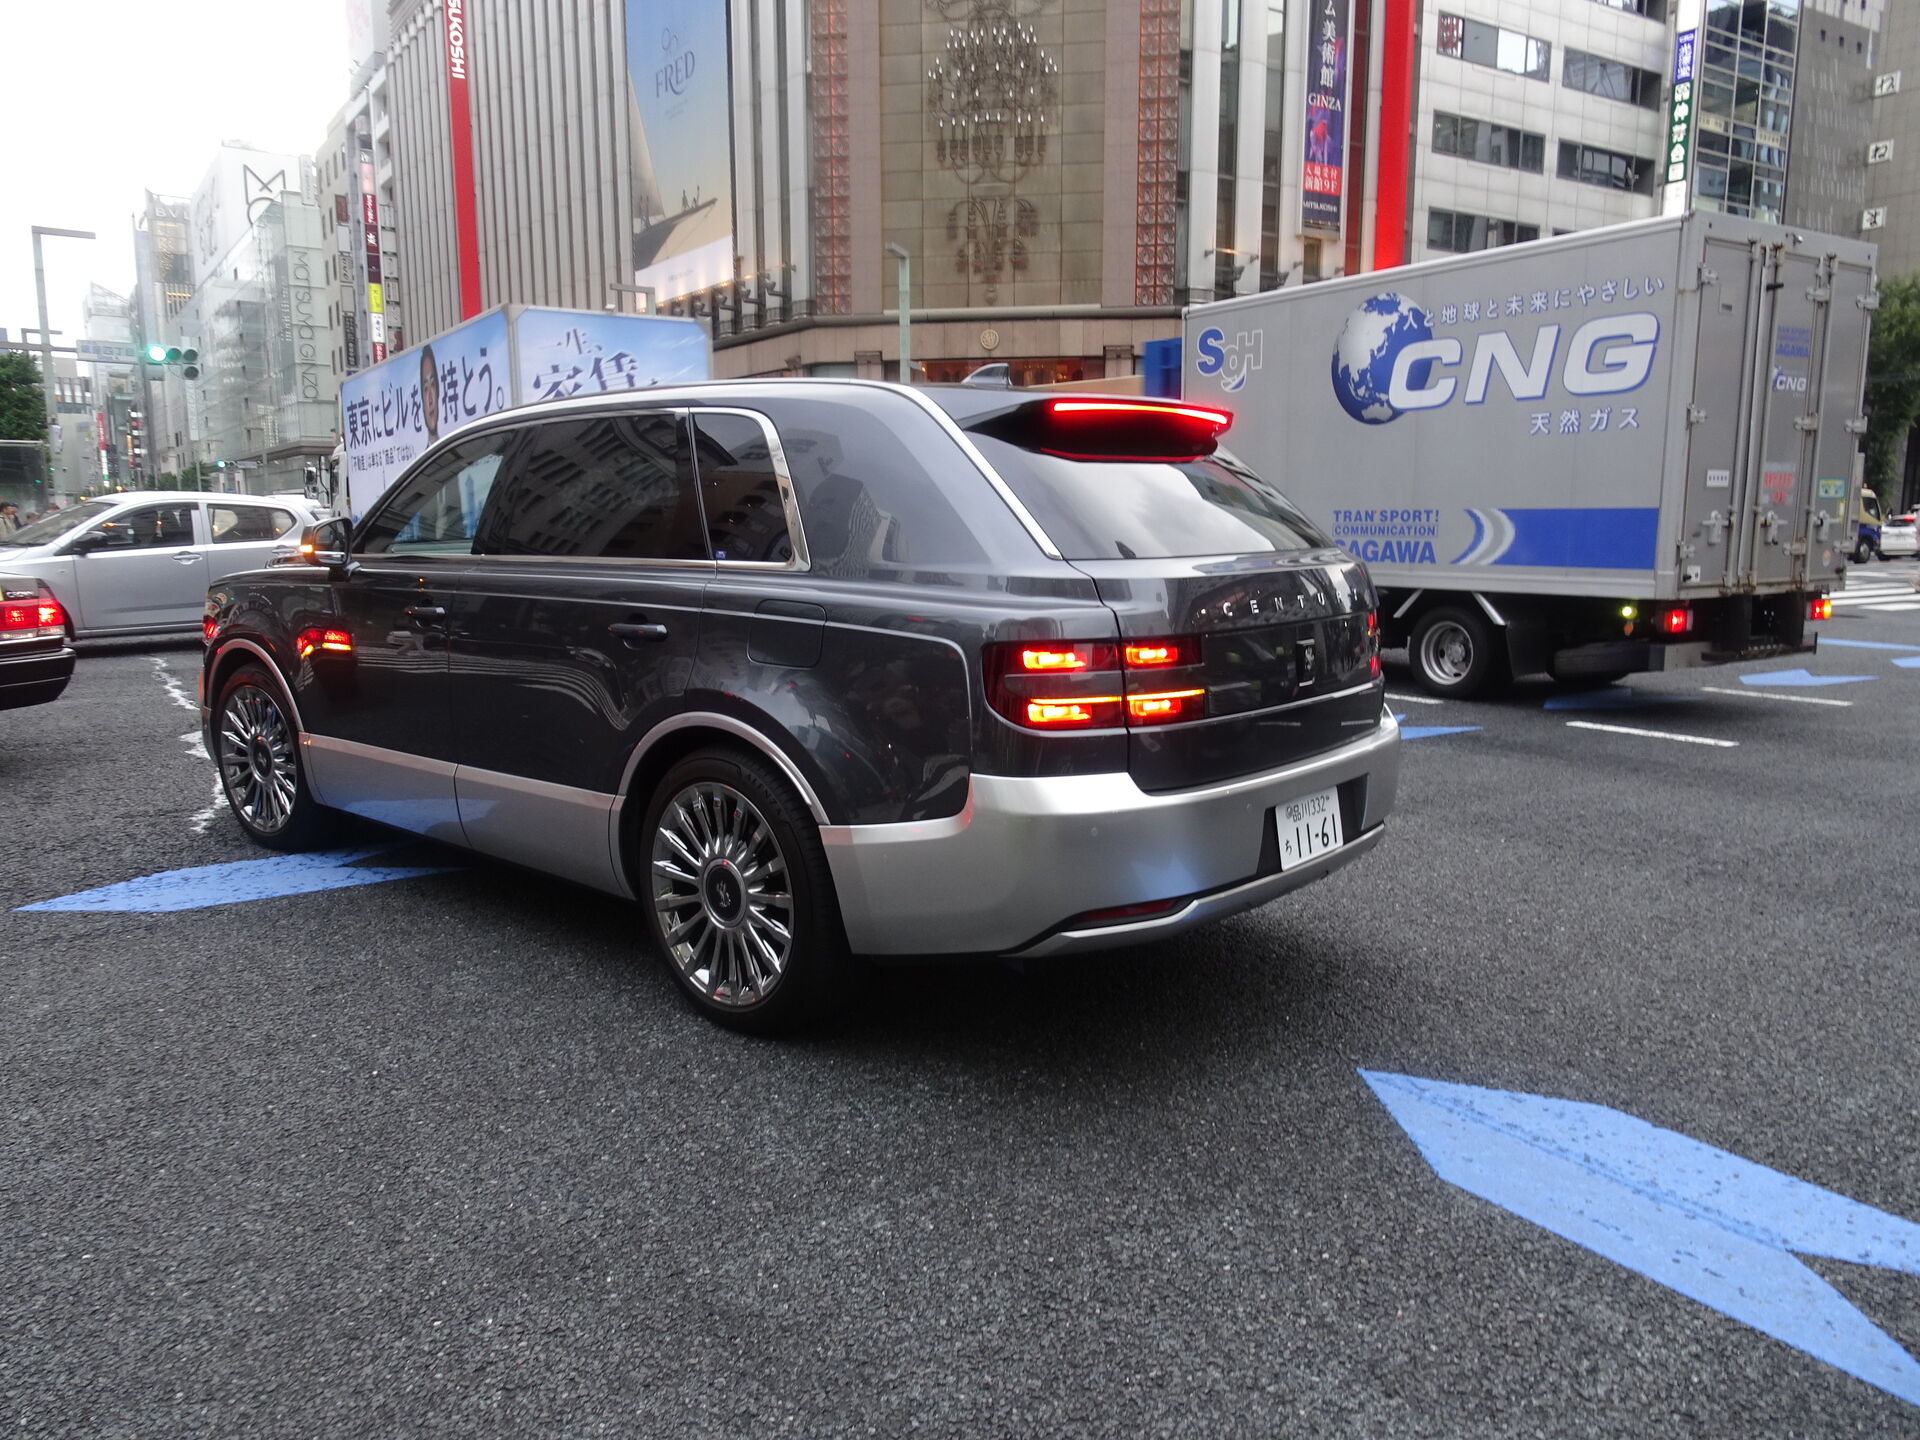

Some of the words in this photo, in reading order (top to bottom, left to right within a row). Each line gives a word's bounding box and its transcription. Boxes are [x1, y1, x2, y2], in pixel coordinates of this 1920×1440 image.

[656, 50, 695, 98] FRED
[1308, 93, 1342, 112] GINZA
[1403, 277, 1665, 331] 人と地球と未来にやさしい
[533, 352, 659, 401] 家賃
[1388, 311, 1661, 411] CNG
[1776, 376, 1807, 391] CNG
[1530, 407, 1640, 435] 天然ガス
[1334, 525, 1436, 537] COMMUNICATION
[1296, 813, 1338, 859] 11-61
